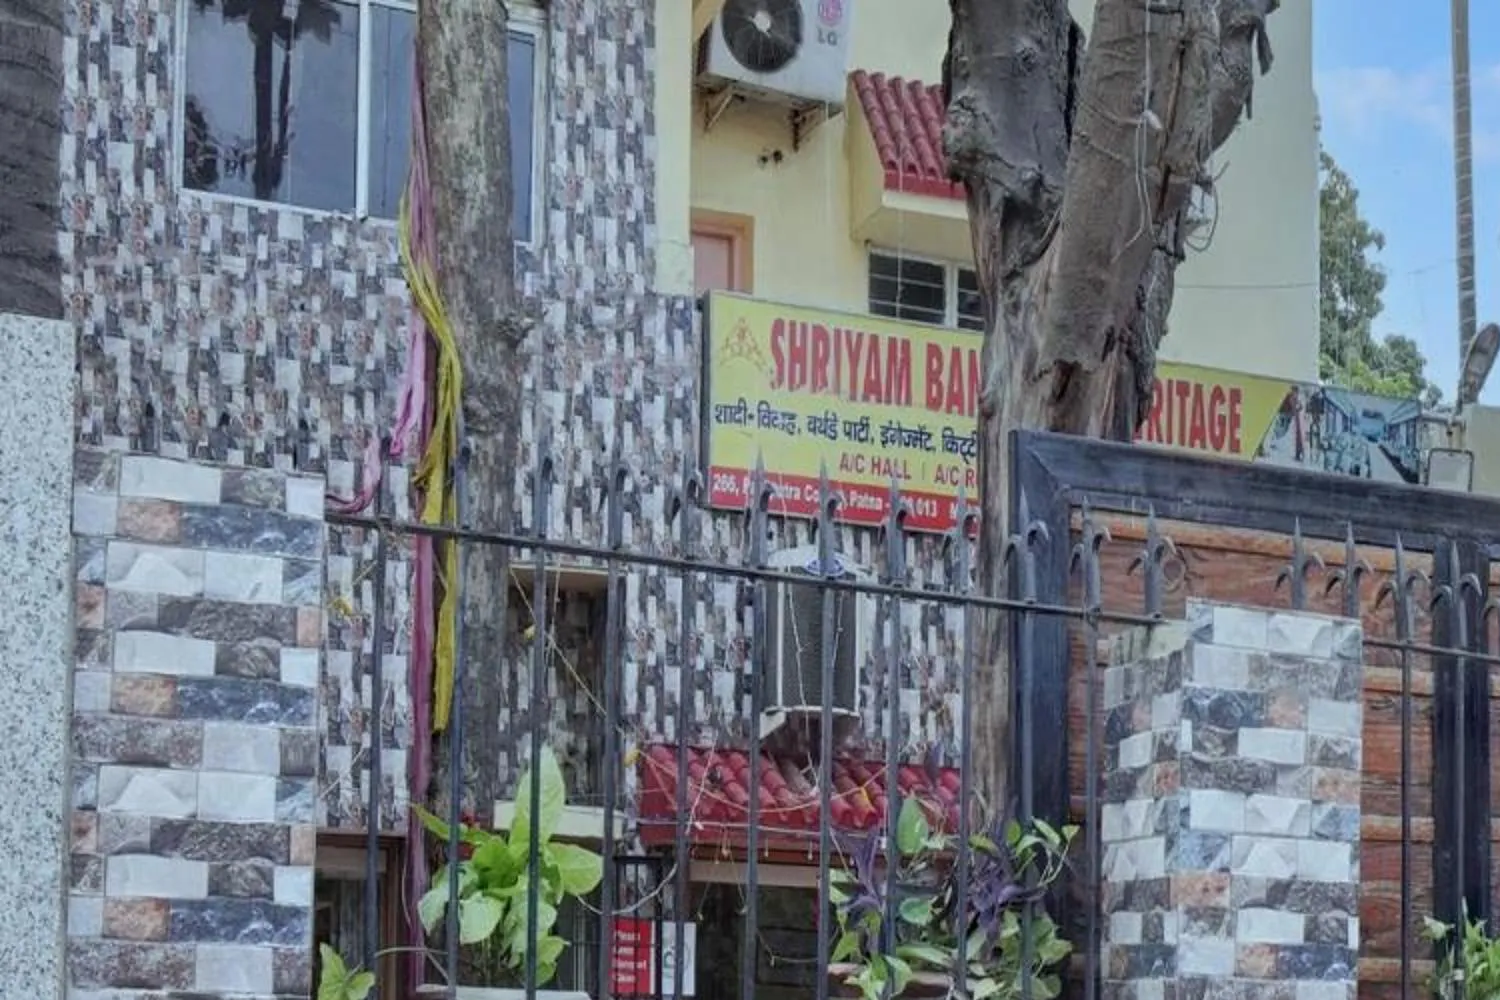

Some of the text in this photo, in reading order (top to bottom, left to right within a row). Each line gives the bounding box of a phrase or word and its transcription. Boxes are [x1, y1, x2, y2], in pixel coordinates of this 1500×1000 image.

[770, 318, 912, 406] SHRIYAM
[1133, 379, 1242, 453] RITAGE
[840, 451, 865, 474] A/C
[871, 456, 911, 480] HALL
[934, 463, 959, 487] A/C
